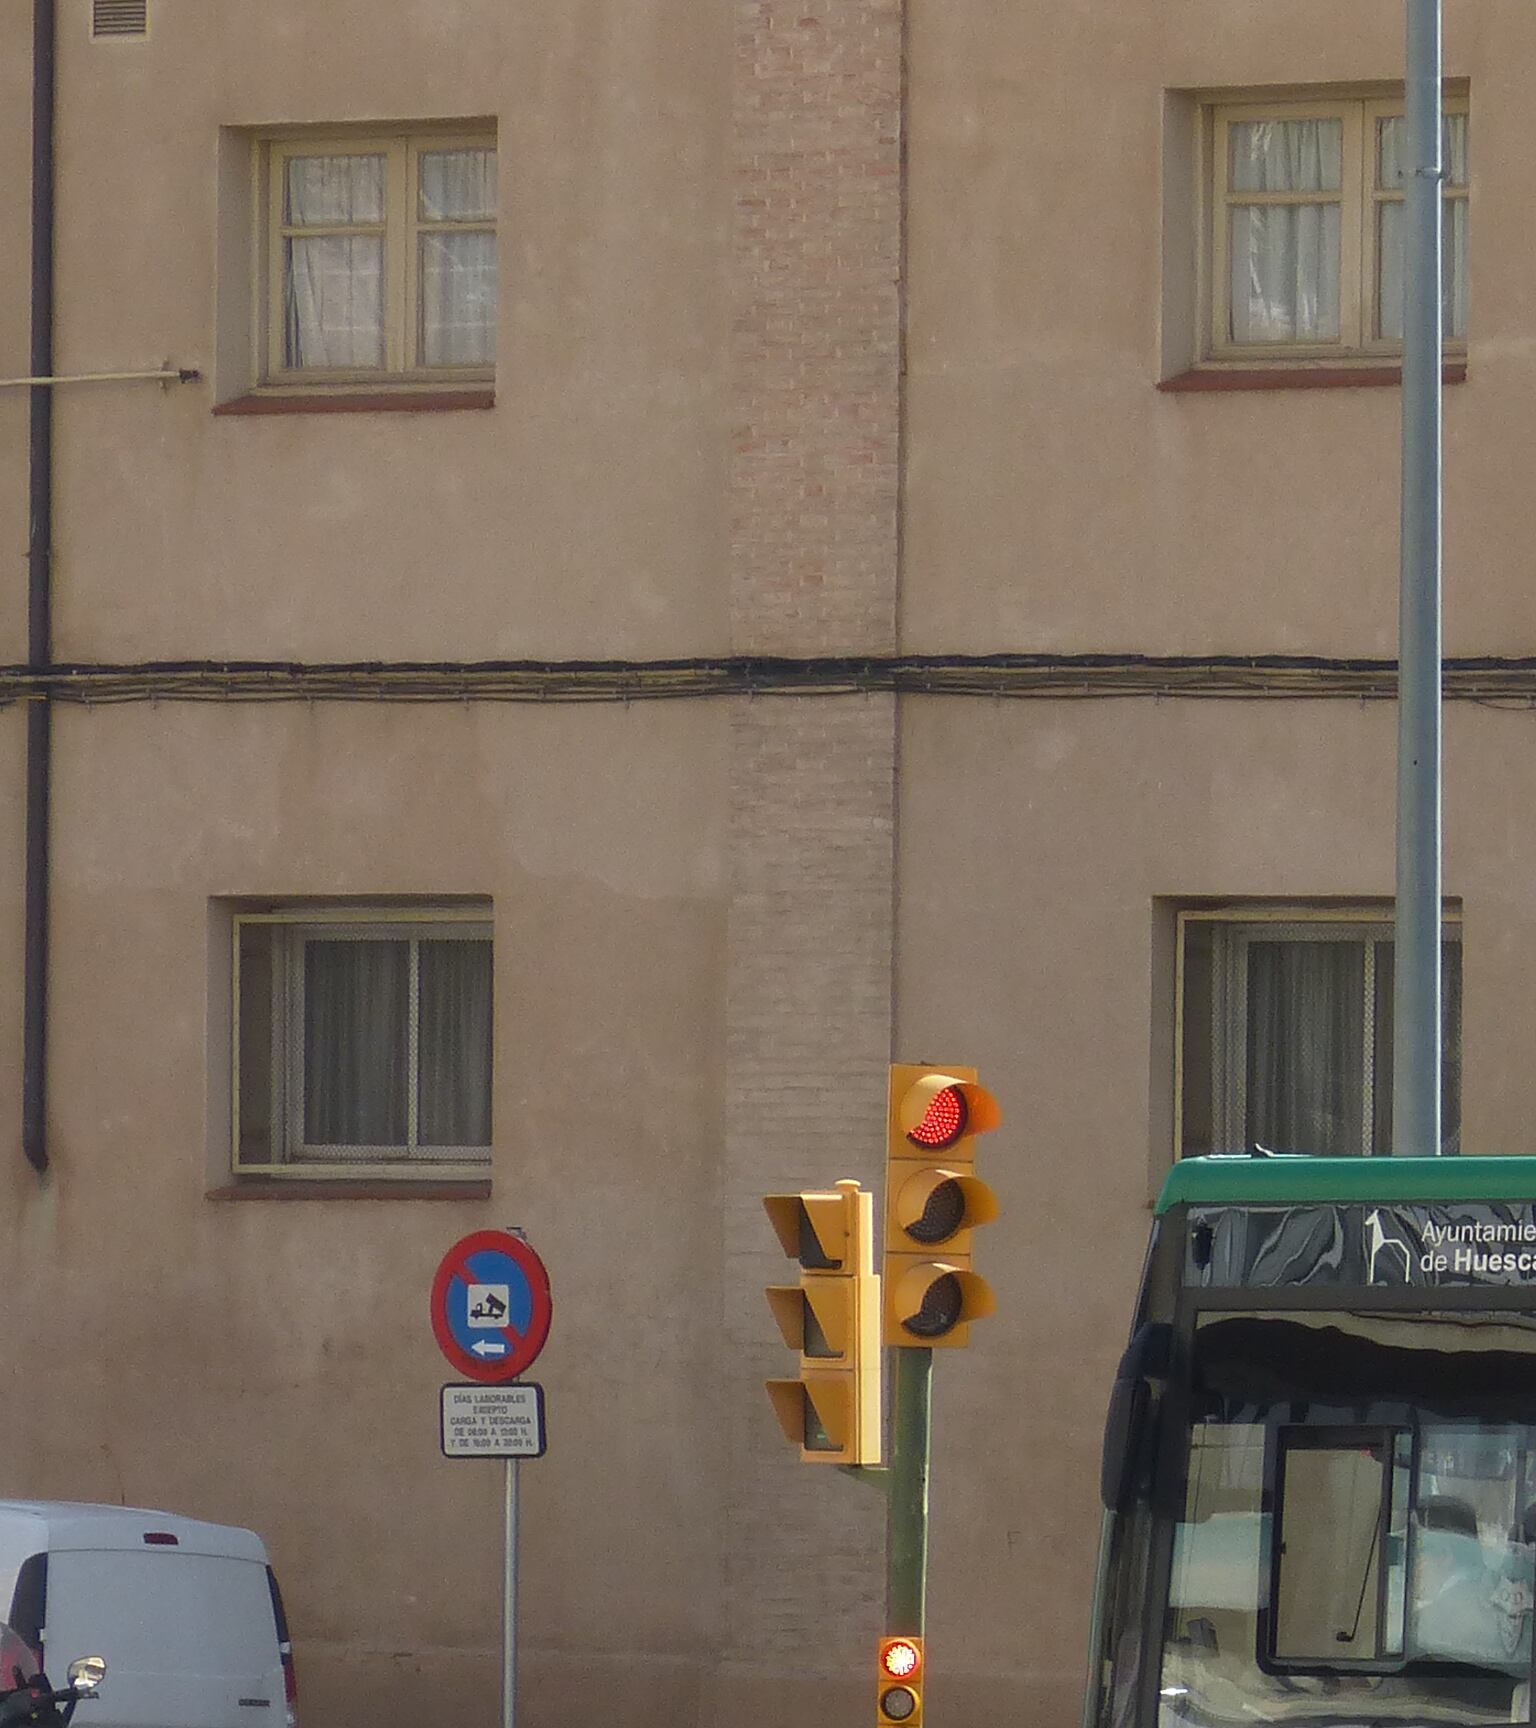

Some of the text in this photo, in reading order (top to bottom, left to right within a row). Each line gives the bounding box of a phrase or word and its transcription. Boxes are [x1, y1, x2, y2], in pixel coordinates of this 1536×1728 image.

[1420, 1250, 1447, 1272] de
[450, 1416, 531, 1425] CARGA Y DESCARGA
[454, 1427, 464, 1436] DE
[490, 1427, 497, 1436] A
[458, 1439, 469, 1447] DE
[495, 1438, 501, 1447] A
